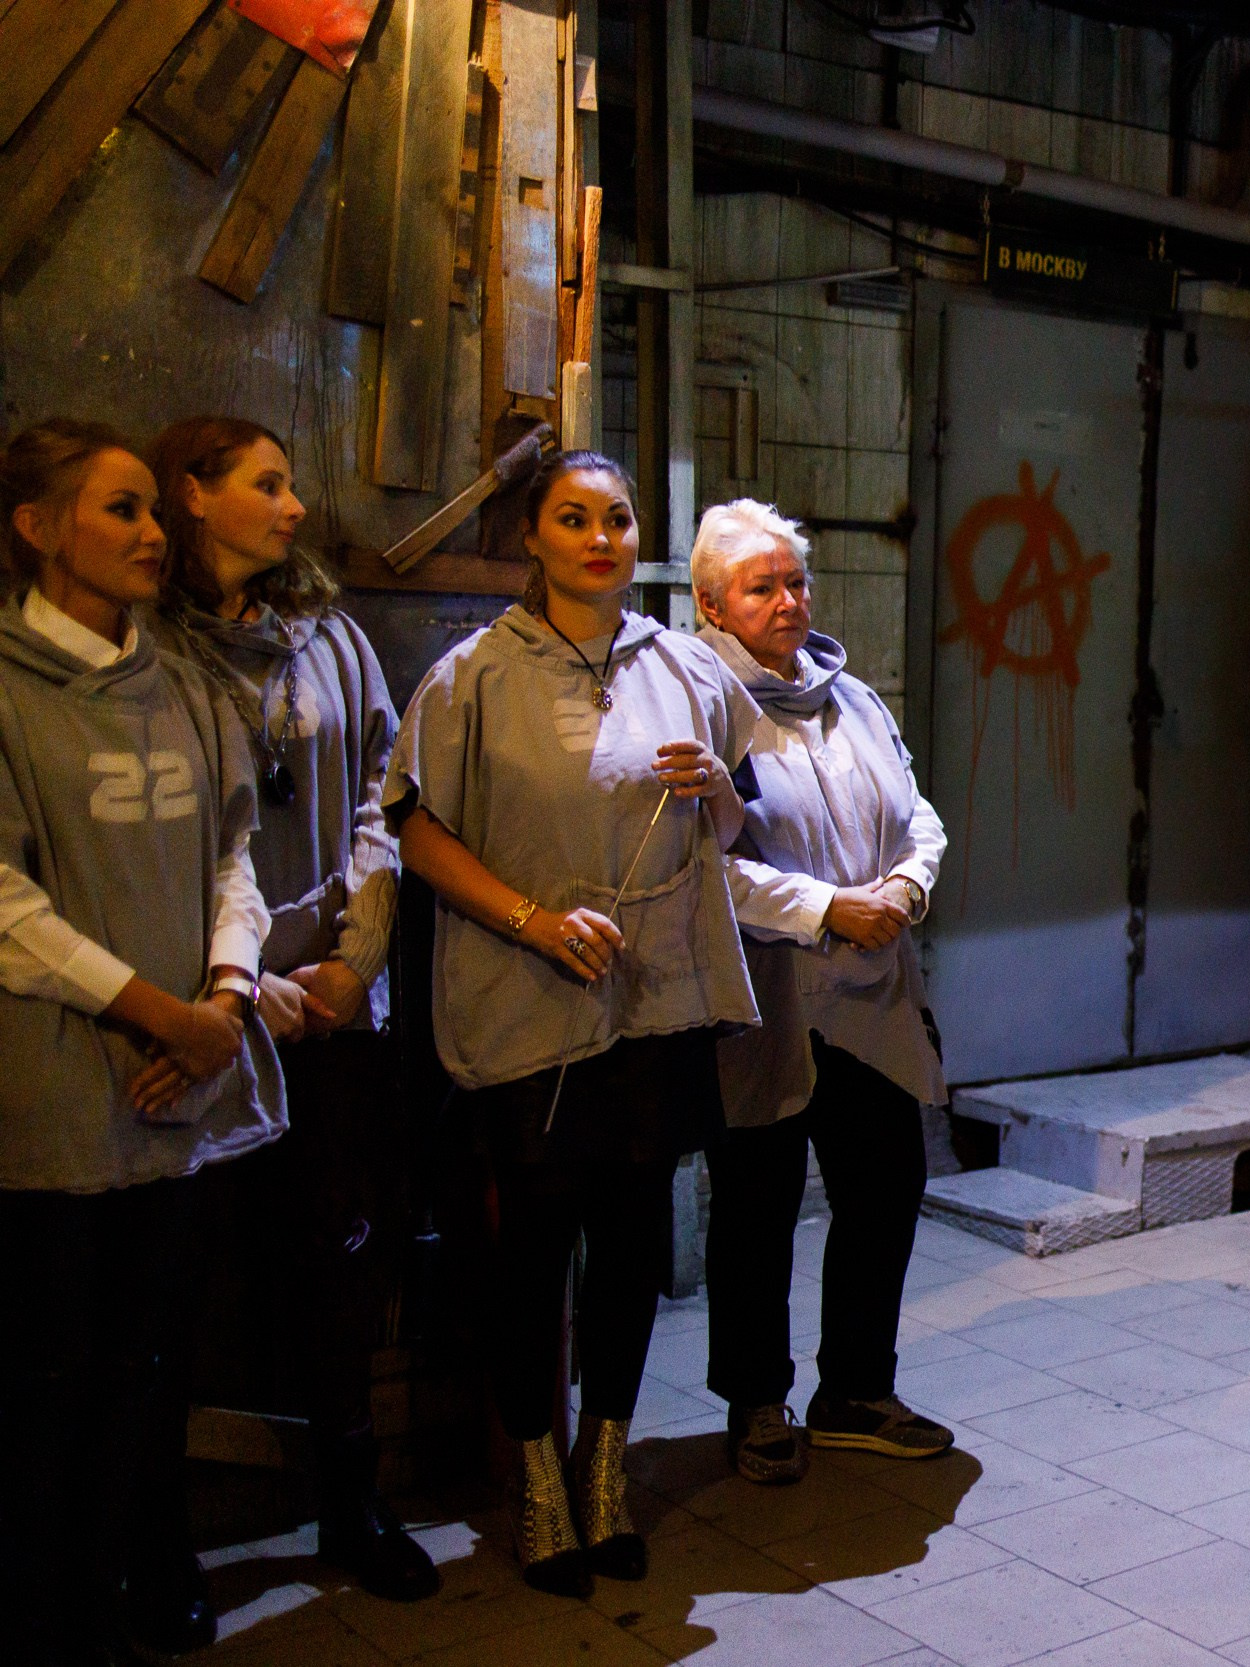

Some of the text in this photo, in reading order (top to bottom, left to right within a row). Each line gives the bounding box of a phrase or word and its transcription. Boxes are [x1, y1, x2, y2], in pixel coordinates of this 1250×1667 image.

[998, 245, 1088, 282] В МОСКВУ
[87, 750, 198, 823] 22
